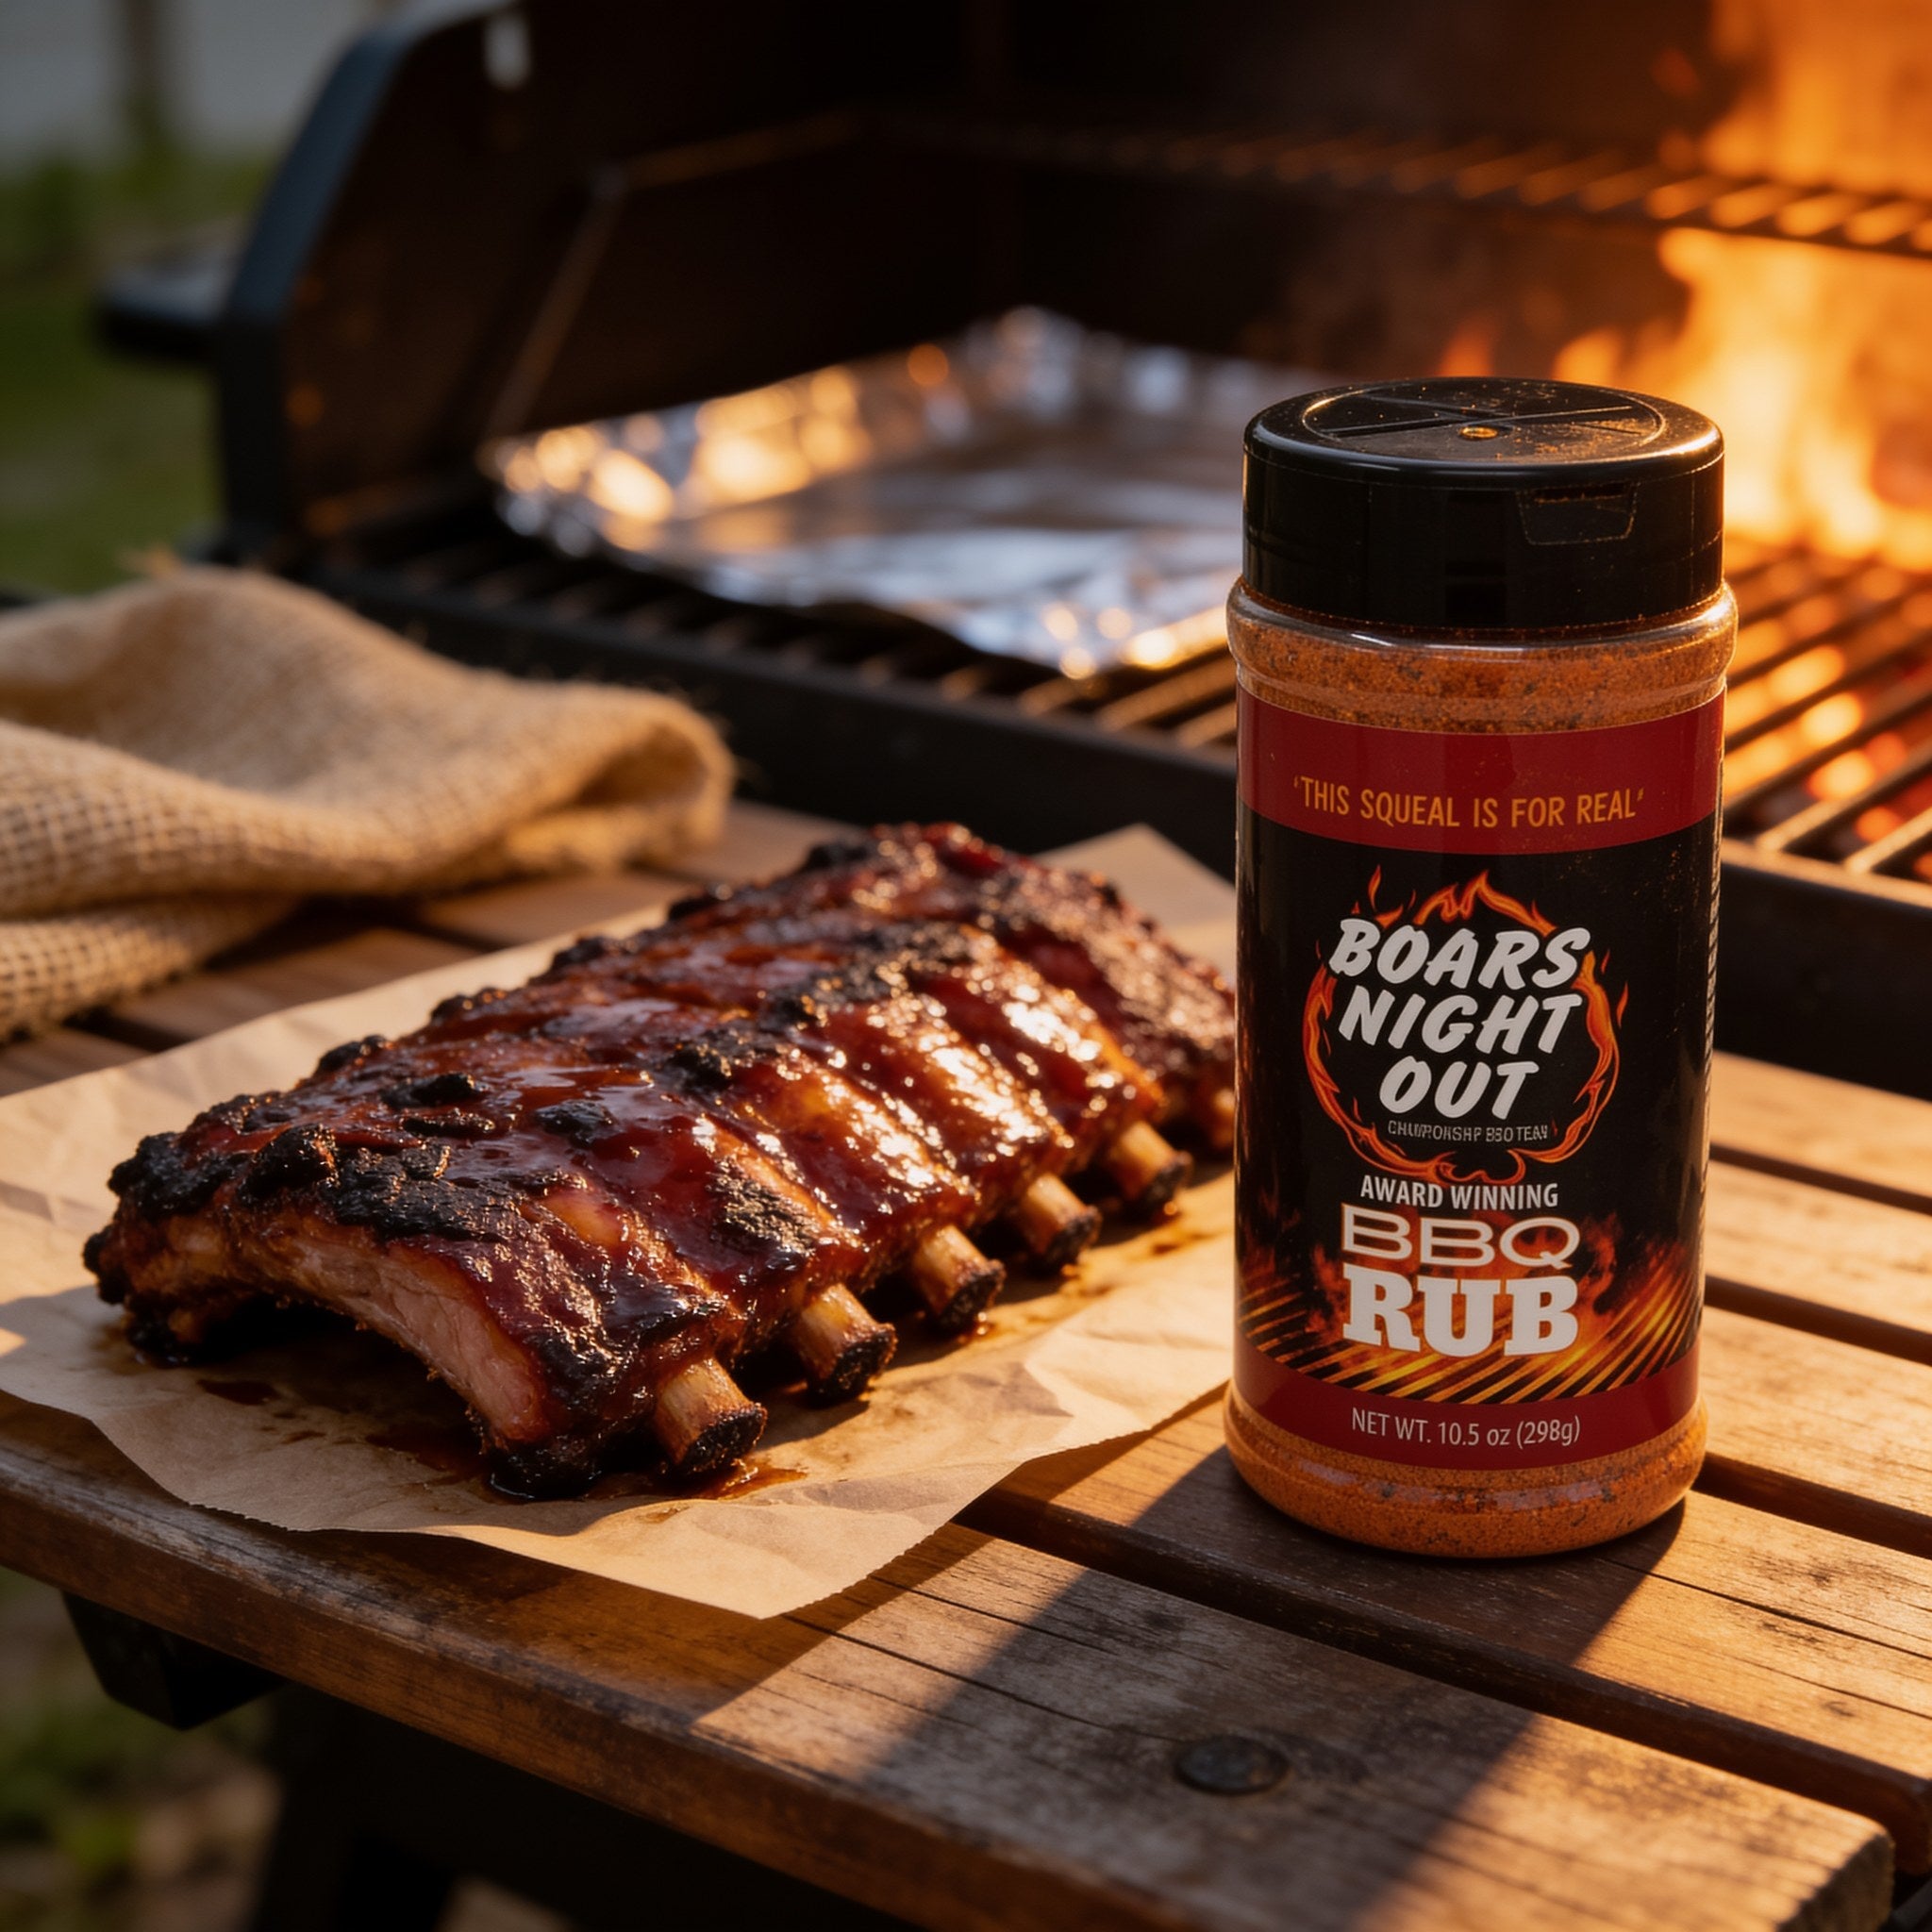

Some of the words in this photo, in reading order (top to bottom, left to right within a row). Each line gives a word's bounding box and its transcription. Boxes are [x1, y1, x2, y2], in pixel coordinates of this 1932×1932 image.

[1359, 788, 1460, 827] SQUEAL
[1474, 798, 1499, 827] IS
[1511, 796, 1566, 827] FOR
[1328, 918, 1591, 991] BOARS
[1338, 985, 1583, 1055] NIGHT
[1379, 1056, 1540, 1120] OUT
[1360, 1174, 1443, 1208] AWARD
[1451, 1182, 1558, 1210] WINNING
[1341, 1202, 1581, 1270] BBQ
[1342, 1262, 1579, 1357] RUB
[1352, 1407, 1390, 1437] NET
[1395, 1416, 1432, 1443] WT.
[1438, 1422, 1480, 1445] 10.5
[1487, 1427, 1511, 1446] oz
[1516, 1415, 1581, 1449] (298g)
